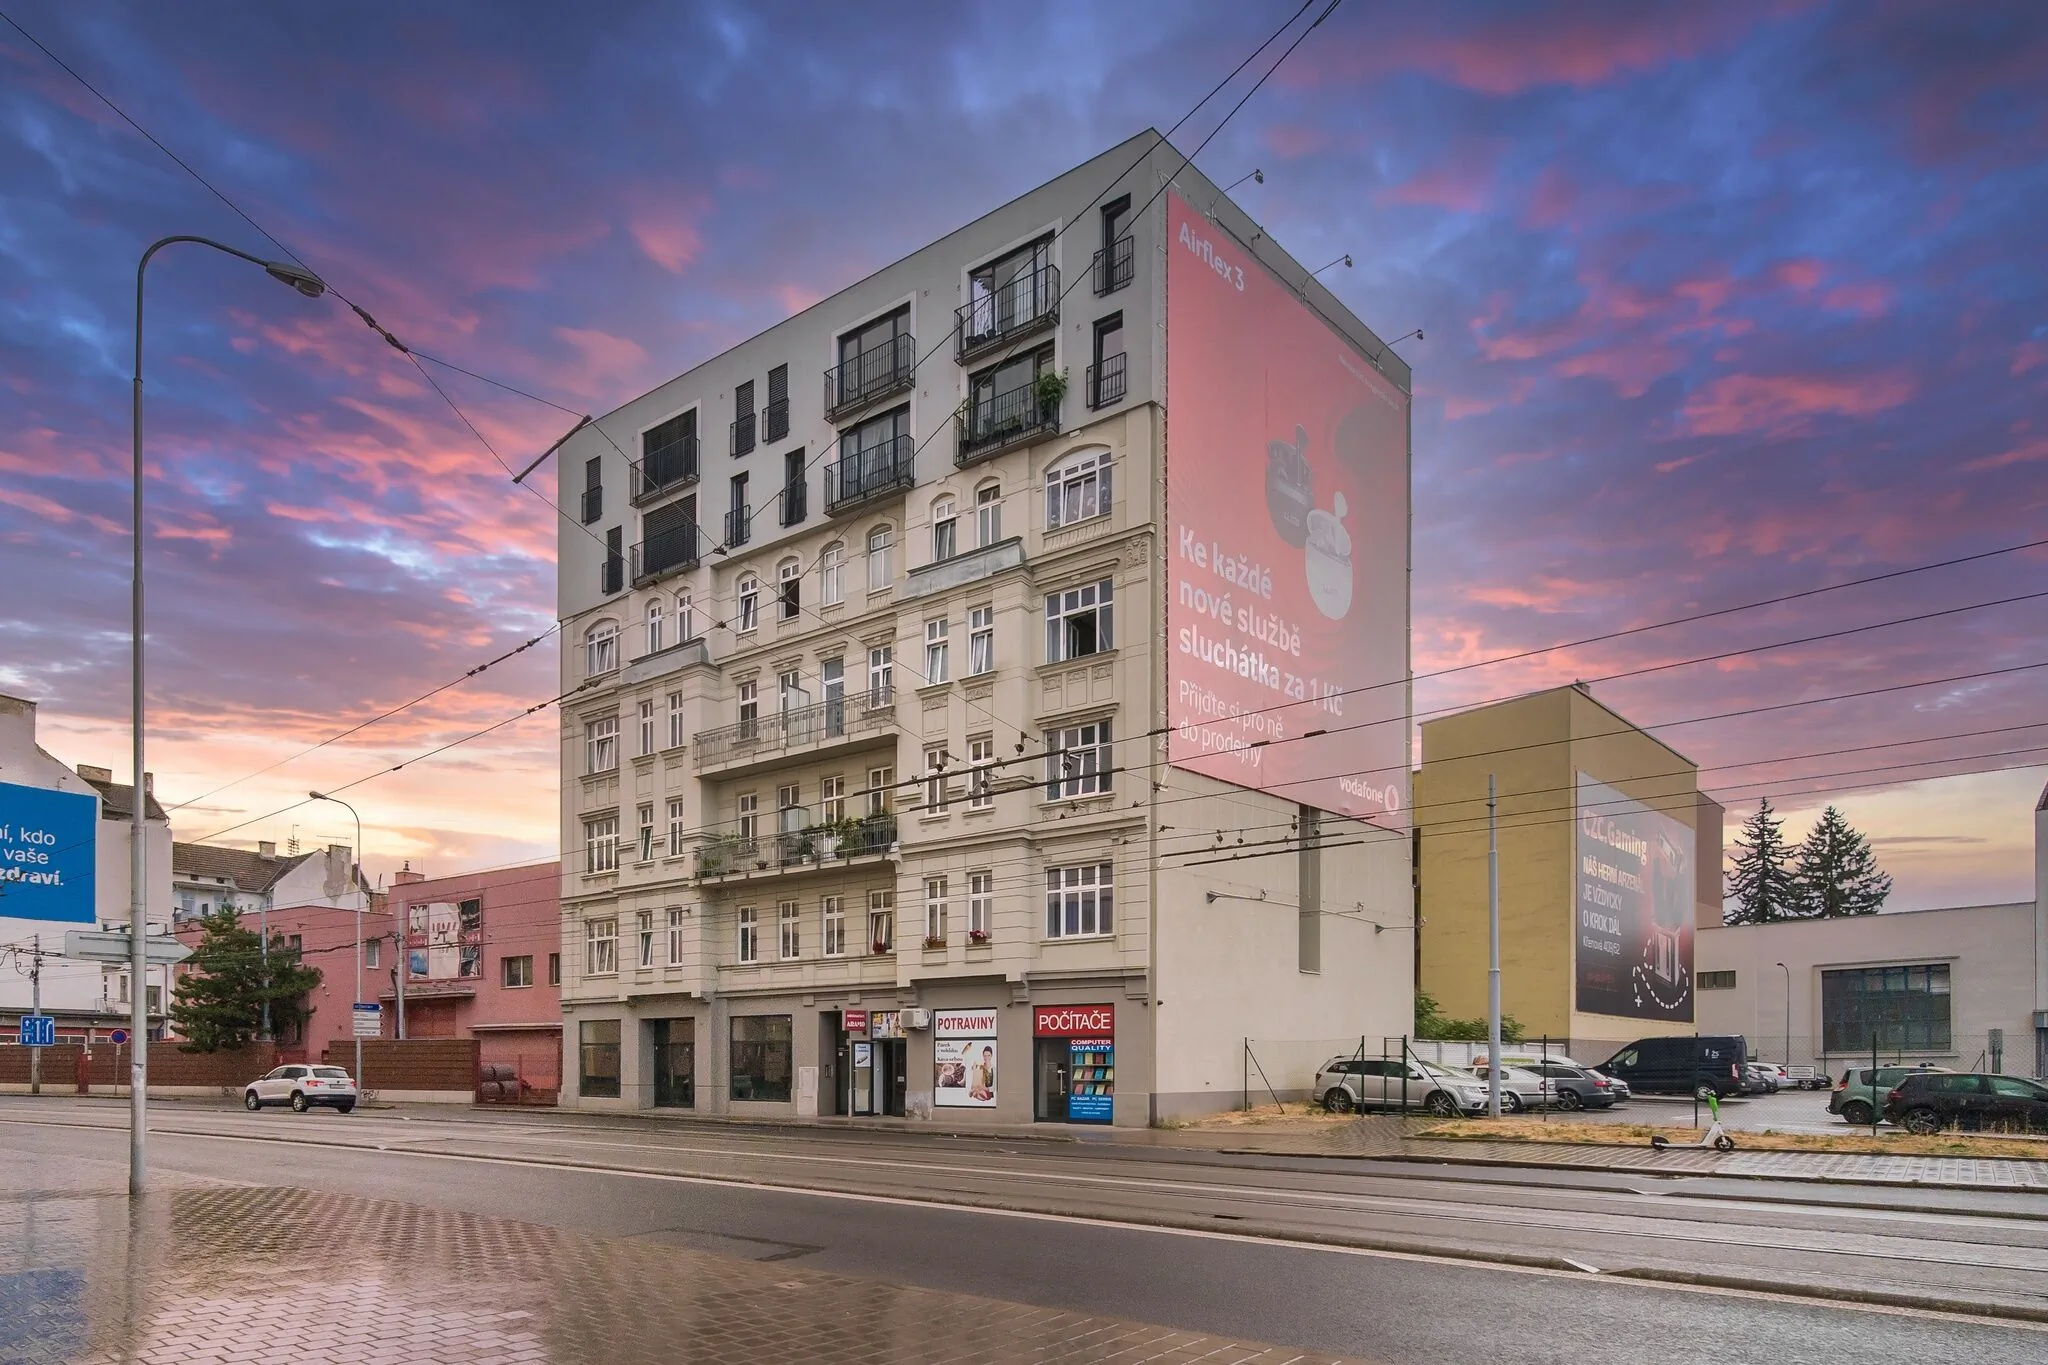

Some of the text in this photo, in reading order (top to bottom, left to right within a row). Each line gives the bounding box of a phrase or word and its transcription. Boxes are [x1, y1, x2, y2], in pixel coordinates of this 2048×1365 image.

[1179, 221, 1244, 292] Airflex 3
[1179, 524, 1272, 600] Ke každé
[1179, 580, 1301, 657] nové službě
[1179, 623, 1343, 717] sluchátka za 1 Kč
[1179, 679, 1284, 739] Přijďte si pro ně
[1179, 716, 1262, 768] do prodejny
[1339, 776, 1384, 804] vodafone
[20, 826, 56, 846] kdo
[3, 847, 49, 865] vaše
[1583, 854, 1598, 878] NÁŠ
[1598, 862, 1618, 885] HERNÍ
[1583, 883, 1623, 911] JE VŽDYCKY
[1583, 910, 1622, 936] O KROK DÁL
[937, 1016, 995, 1031] POTRAVINY
[1039, 1010, 1111, 1031] POČÍTAČE
